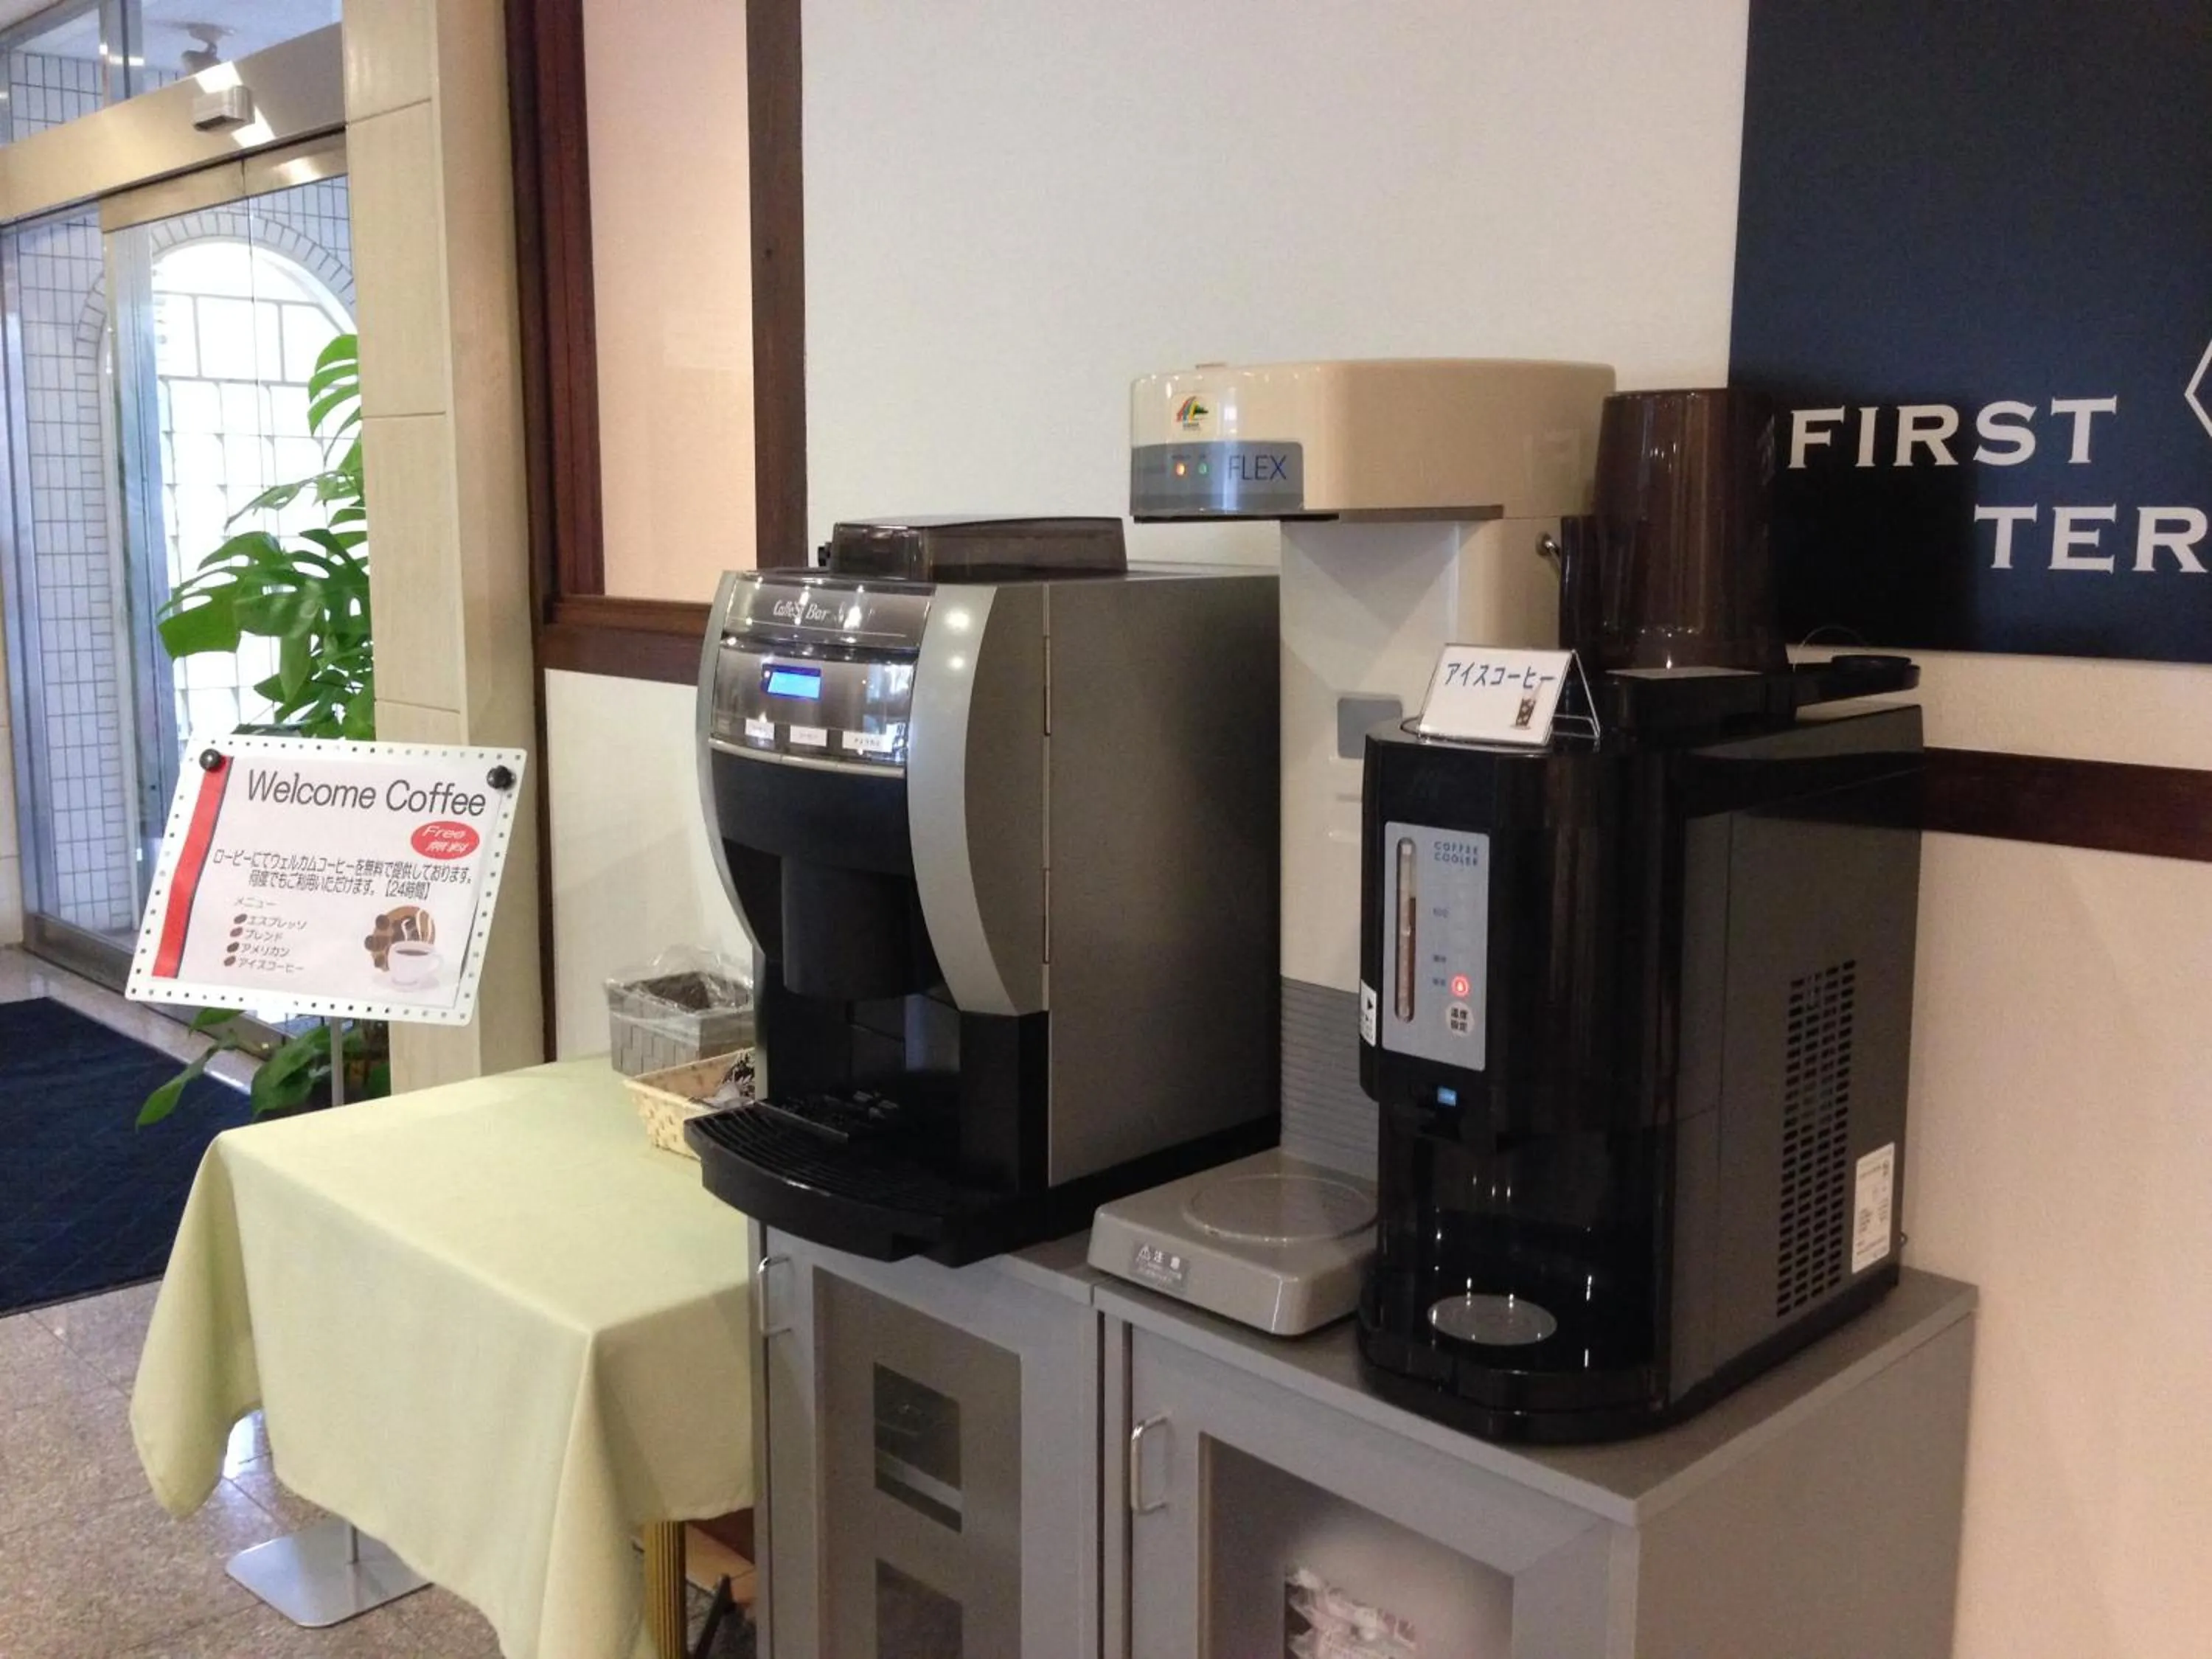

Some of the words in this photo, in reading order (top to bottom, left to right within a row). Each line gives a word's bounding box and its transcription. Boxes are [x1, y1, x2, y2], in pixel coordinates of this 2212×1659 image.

[1787, 394, 2118, 469] FIRST
[1229, 453, 1287, 480] FLEX
[1974, 502, 2209, 574] TER
[1445, 662, 1556, 689] アイスコーヒー
[248, 768, 376, 810] Welcome
[386, 779, 487, 816] Coffee
[422, 825, 467, 840] Free
[234, 897, 277, 909] メニュー
[243, 929, 284, 942] ブレンド
[240, 943, 291, 958] アメリカン
[237, 958, 305, 974] アイスコーヒー
